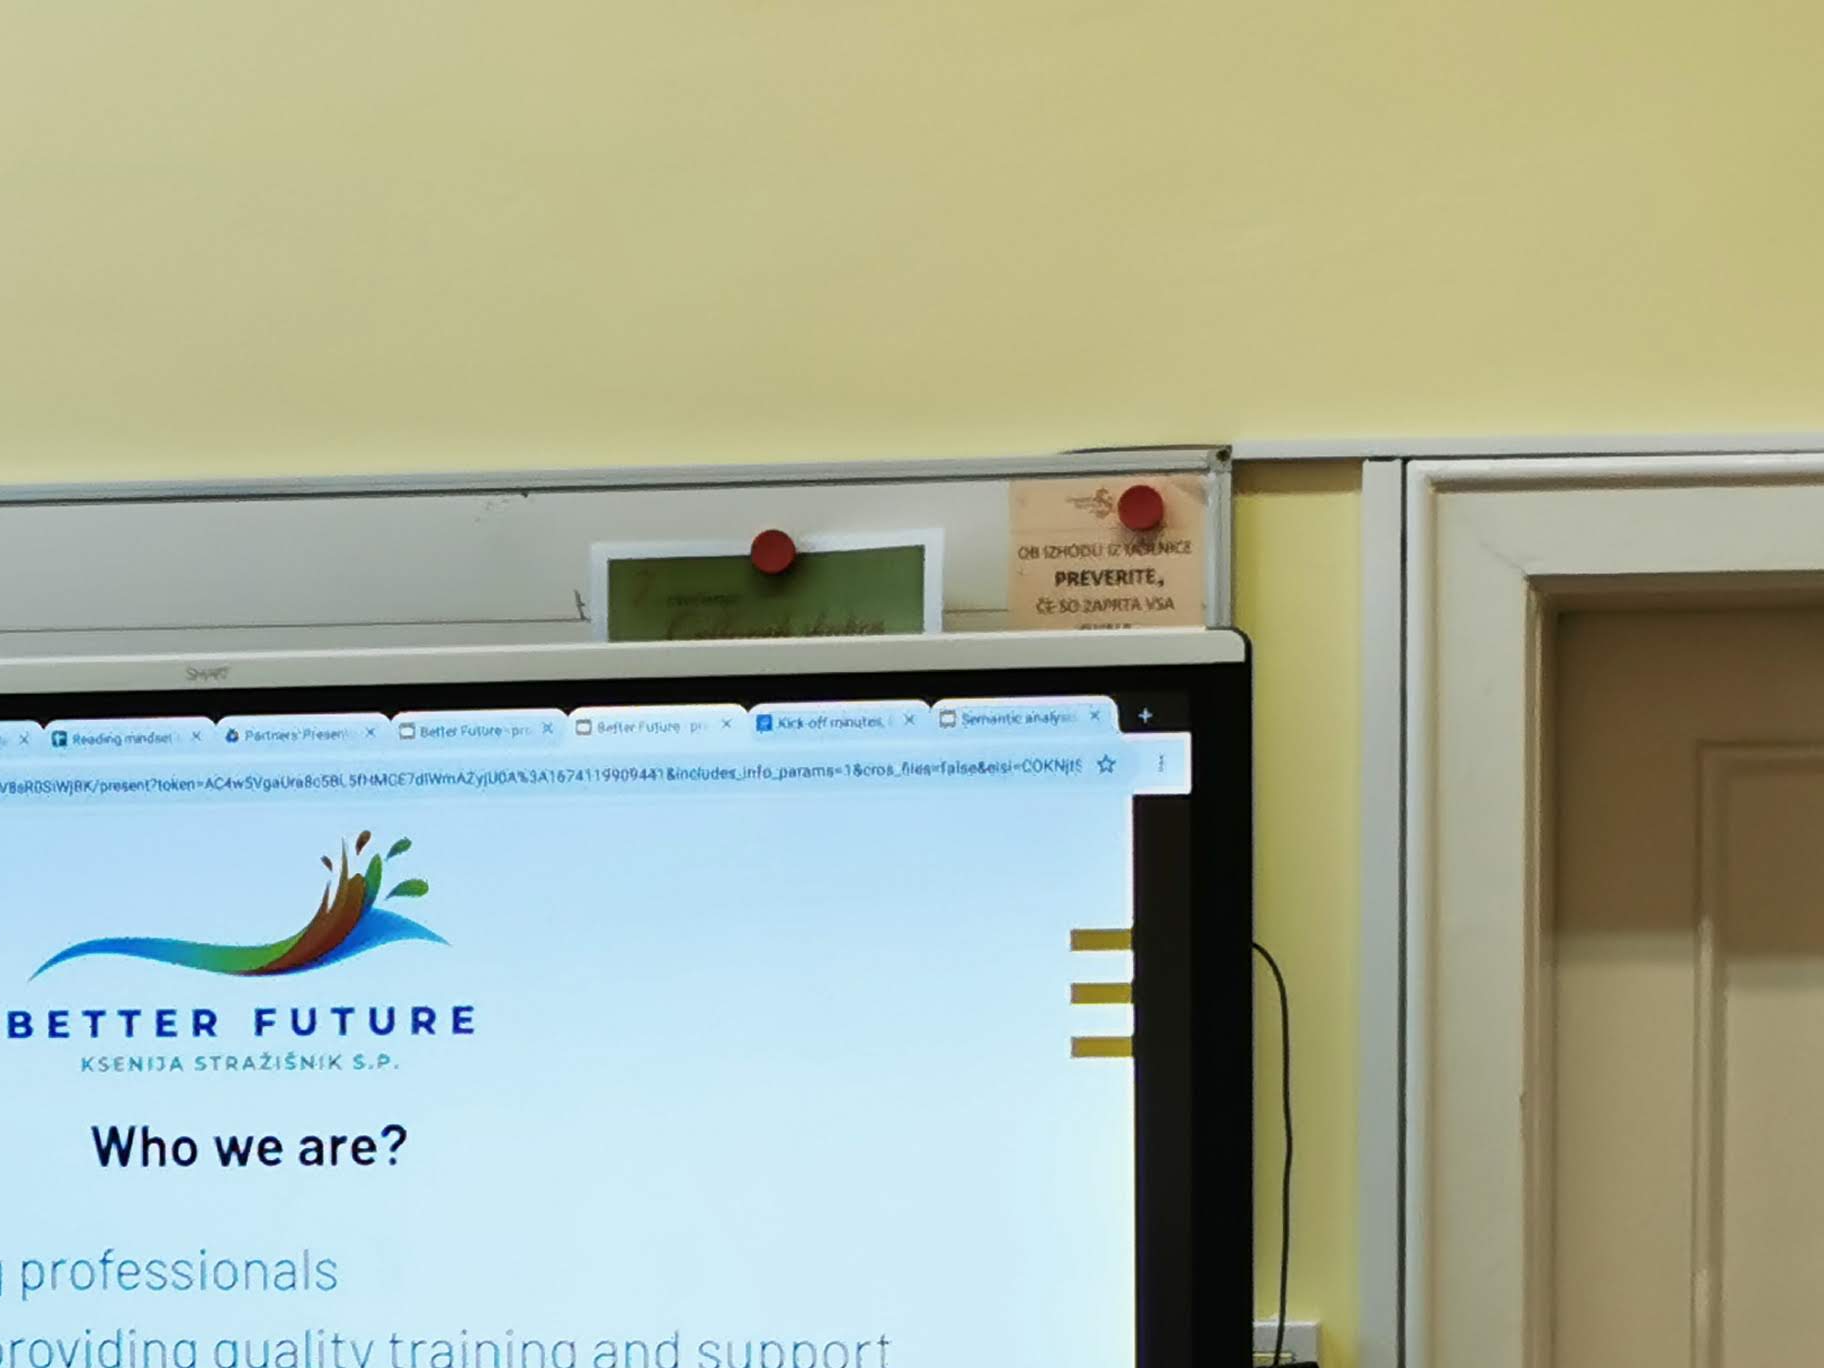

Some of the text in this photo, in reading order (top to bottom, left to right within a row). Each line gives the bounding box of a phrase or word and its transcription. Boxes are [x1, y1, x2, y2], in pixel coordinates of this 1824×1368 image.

[1054, 567, 1165, 588] PREVERITE,
[597, 720, 634, 734] Better
[638, 719, 681, 734] Future
[960, 709, 1022, 727] Semantic
[72, 732, 123, 747] Reading
[420, 725, 458, 738] Better
[460, 723, 502, 737] Future
[8, 1005, 476, 1039] BETTER FUTURE
[81, 1051, 400, 1073] KSENIJA STRAŽIŠNIK S.P.
[92, 1123, 408, 1168] Who we are?
[21, 1248, 338, 1302] professionals
